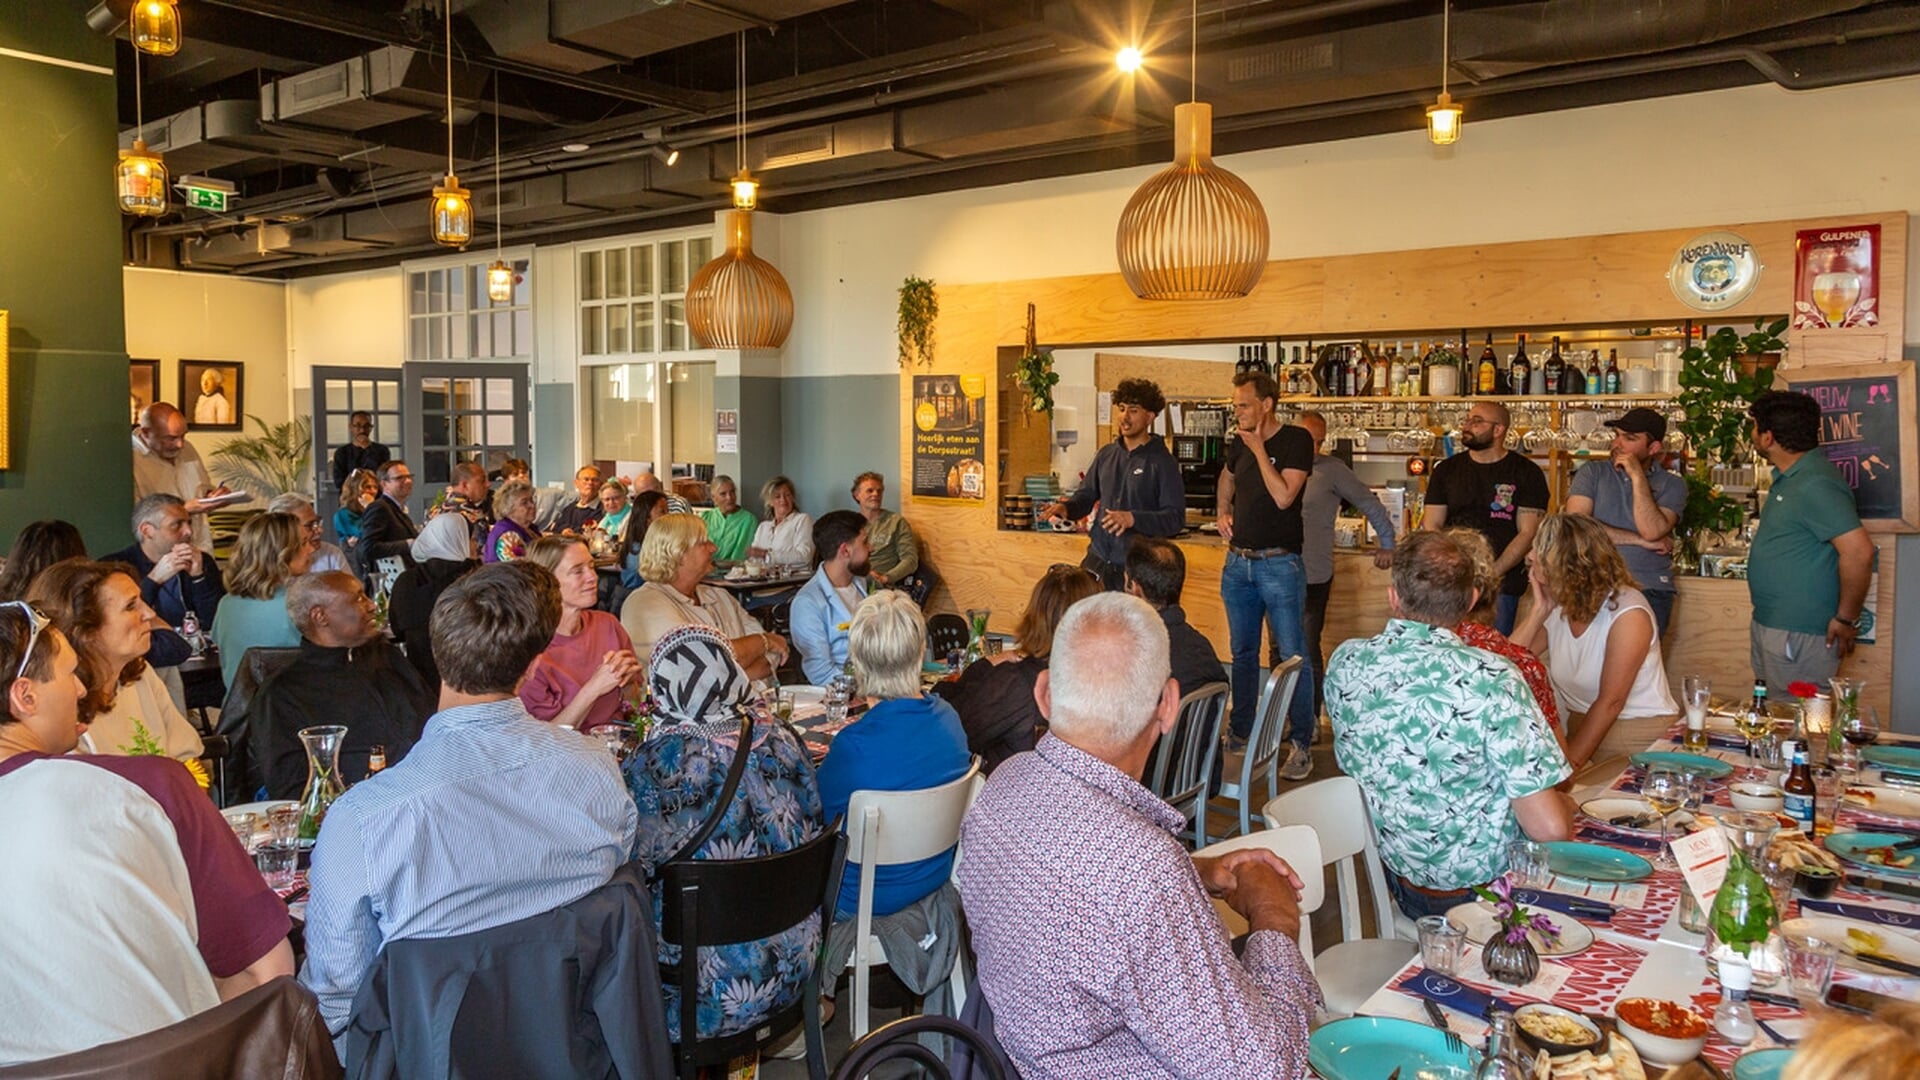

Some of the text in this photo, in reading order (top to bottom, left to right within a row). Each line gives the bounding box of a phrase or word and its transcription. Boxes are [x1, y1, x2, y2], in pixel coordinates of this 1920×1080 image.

[1820, 230, 1870, 241] GULPENER
[917, 434, 945, 444] Heerlijk
[946, 435, 964, 443] eten
[928, 446, 976, 456] Dorpsstraat!
